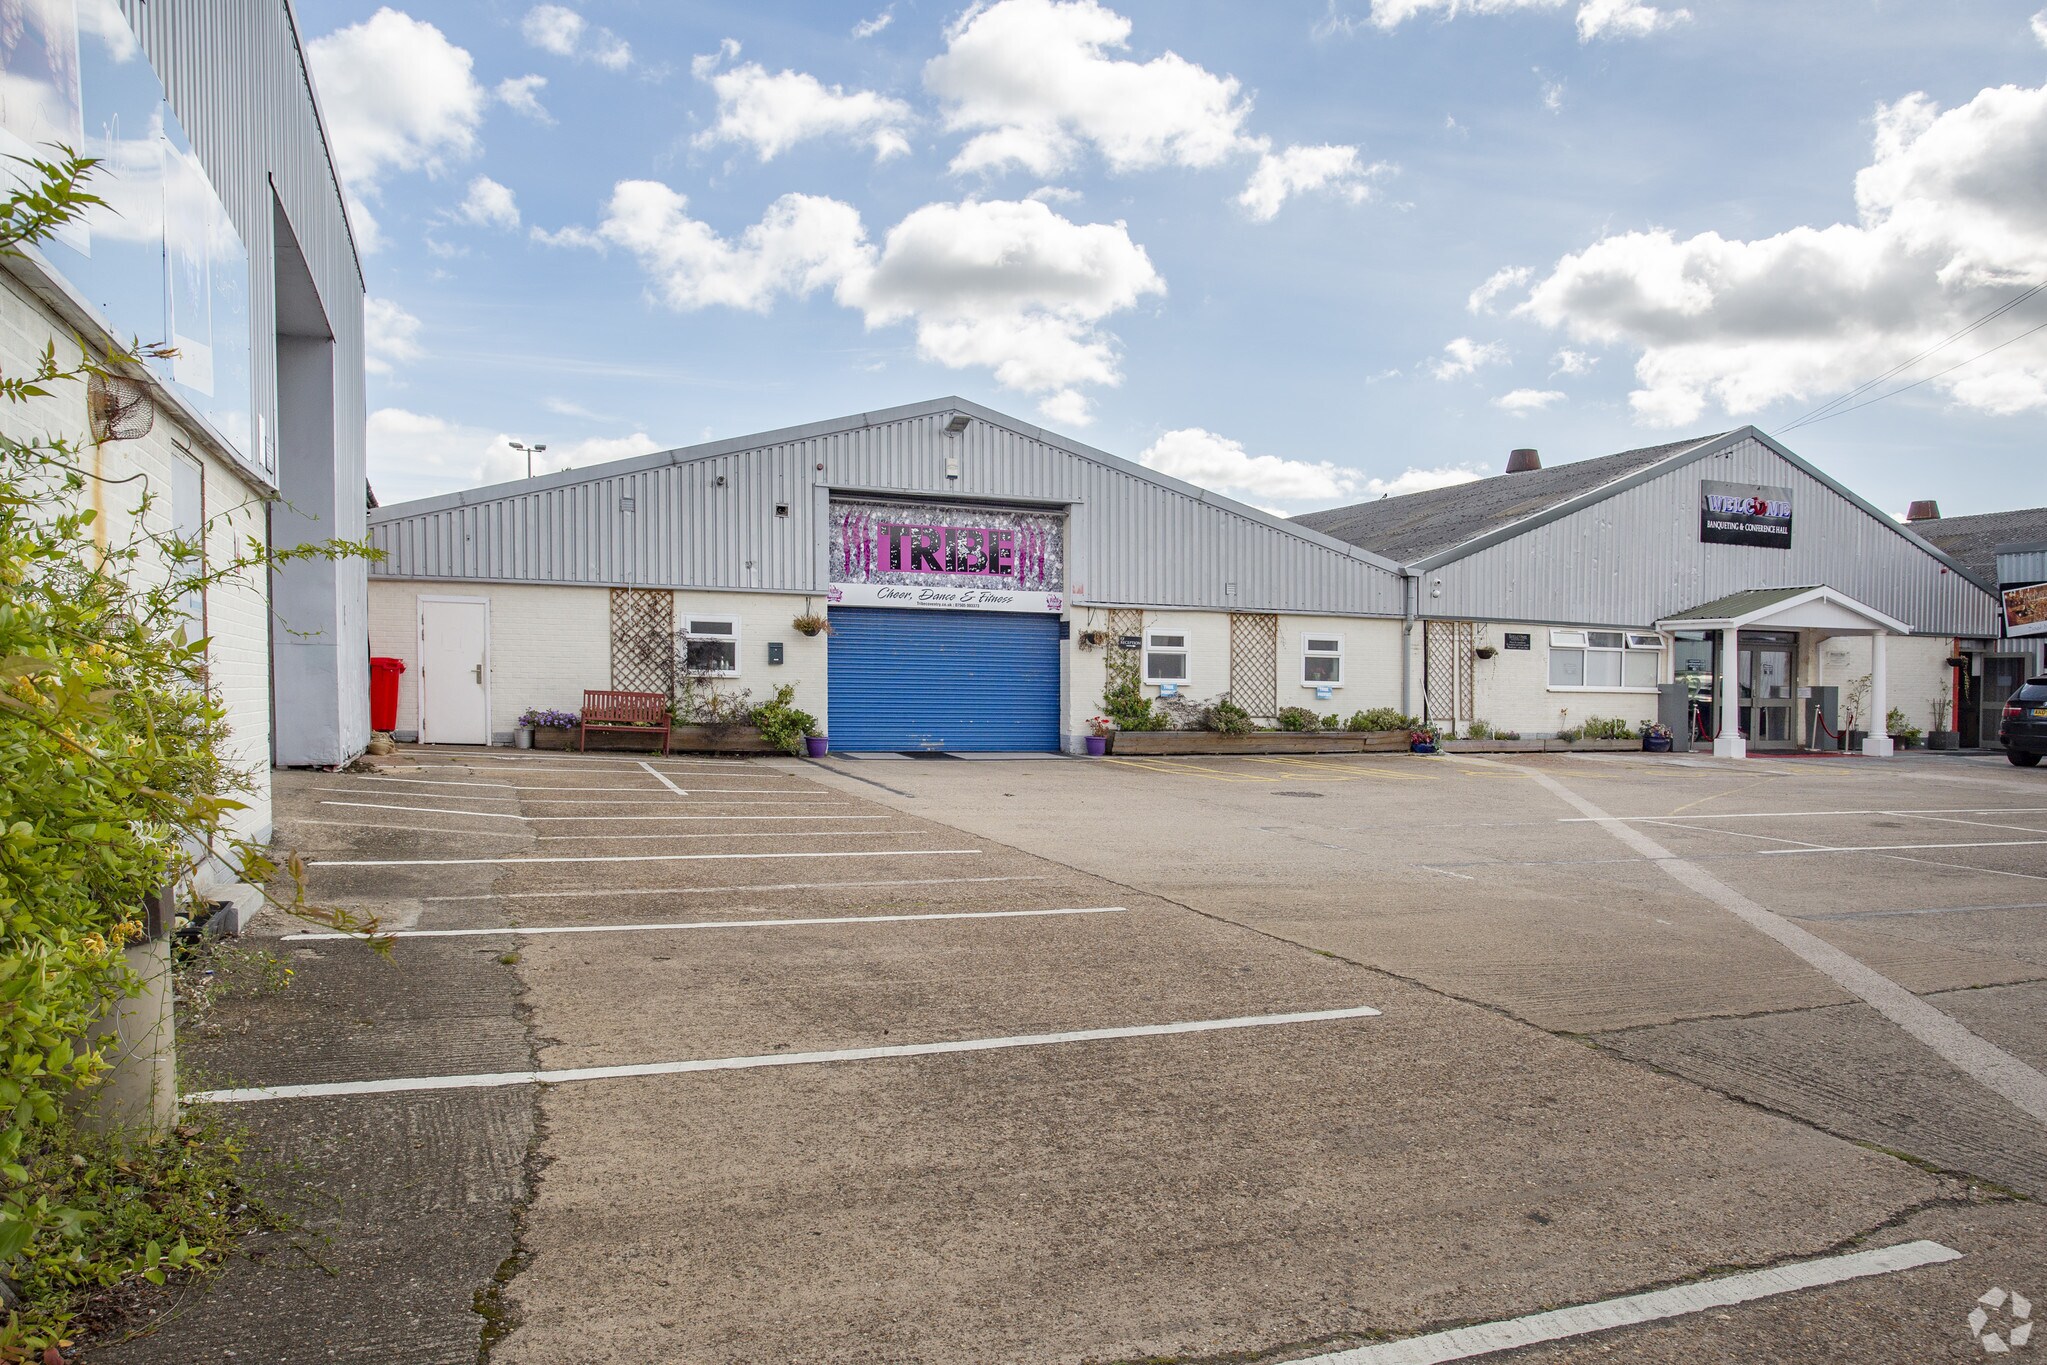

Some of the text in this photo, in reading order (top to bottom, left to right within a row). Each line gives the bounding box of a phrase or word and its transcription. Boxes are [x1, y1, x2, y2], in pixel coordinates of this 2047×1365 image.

[1706, 495, 1791, 519] WELCOME
[1707, 520, 1788, 535] BANQUETING & CONFERENCE HALL
[880, 526, 1012, 574] TRIBE
[877, 586, 1013, 604] Cheer, Dance & Fitness
